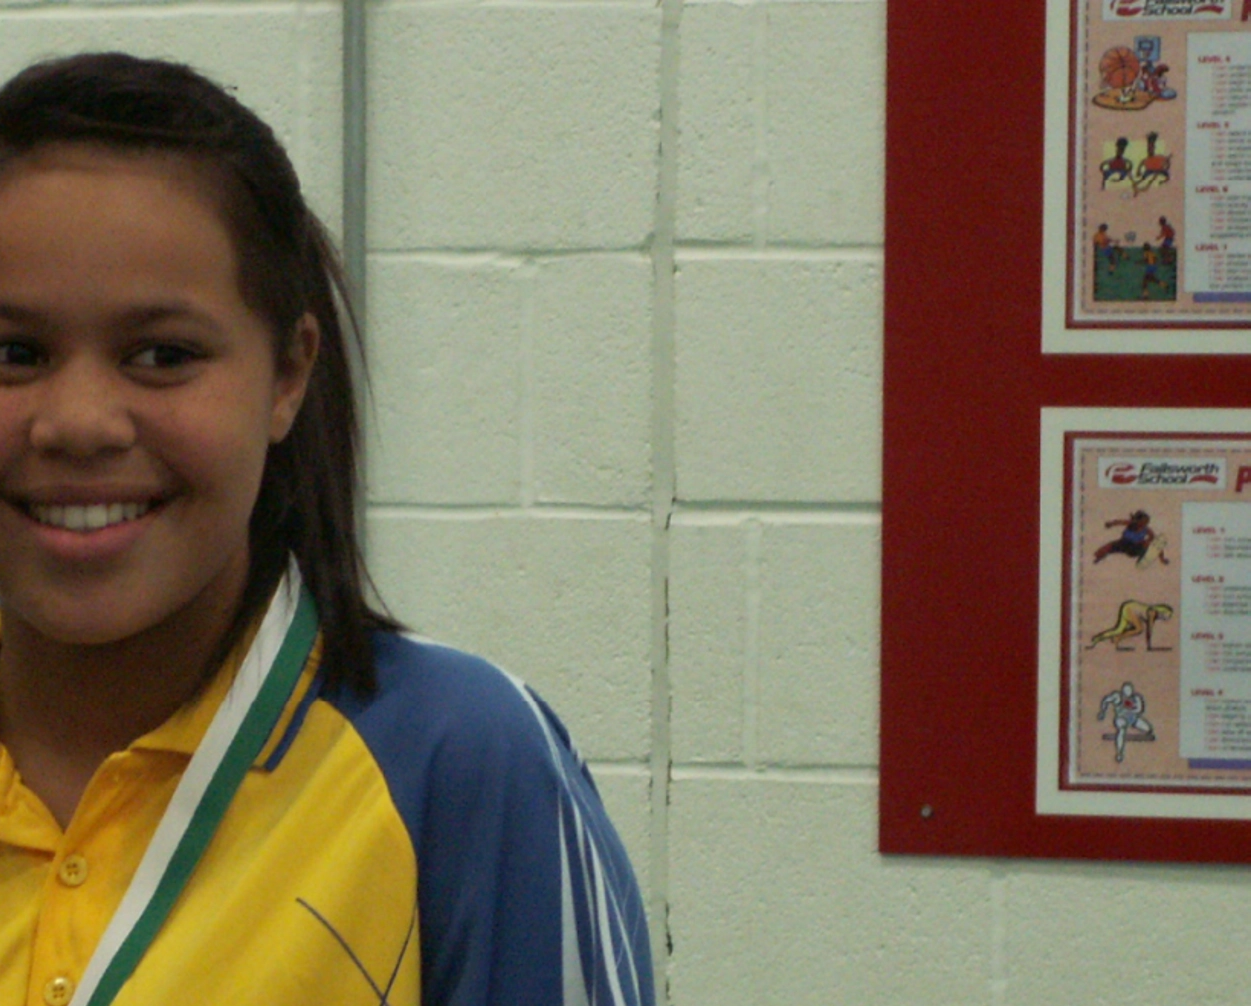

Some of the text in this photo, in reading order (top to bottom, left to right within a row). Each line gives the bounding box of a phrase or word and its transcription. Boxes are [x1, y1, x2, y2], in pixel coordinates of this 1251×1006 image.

[1142, 5, 1192, 15] School
[1140, 463, 1220, 474] Failsworth
[1138, 474, 1187, 484] School
